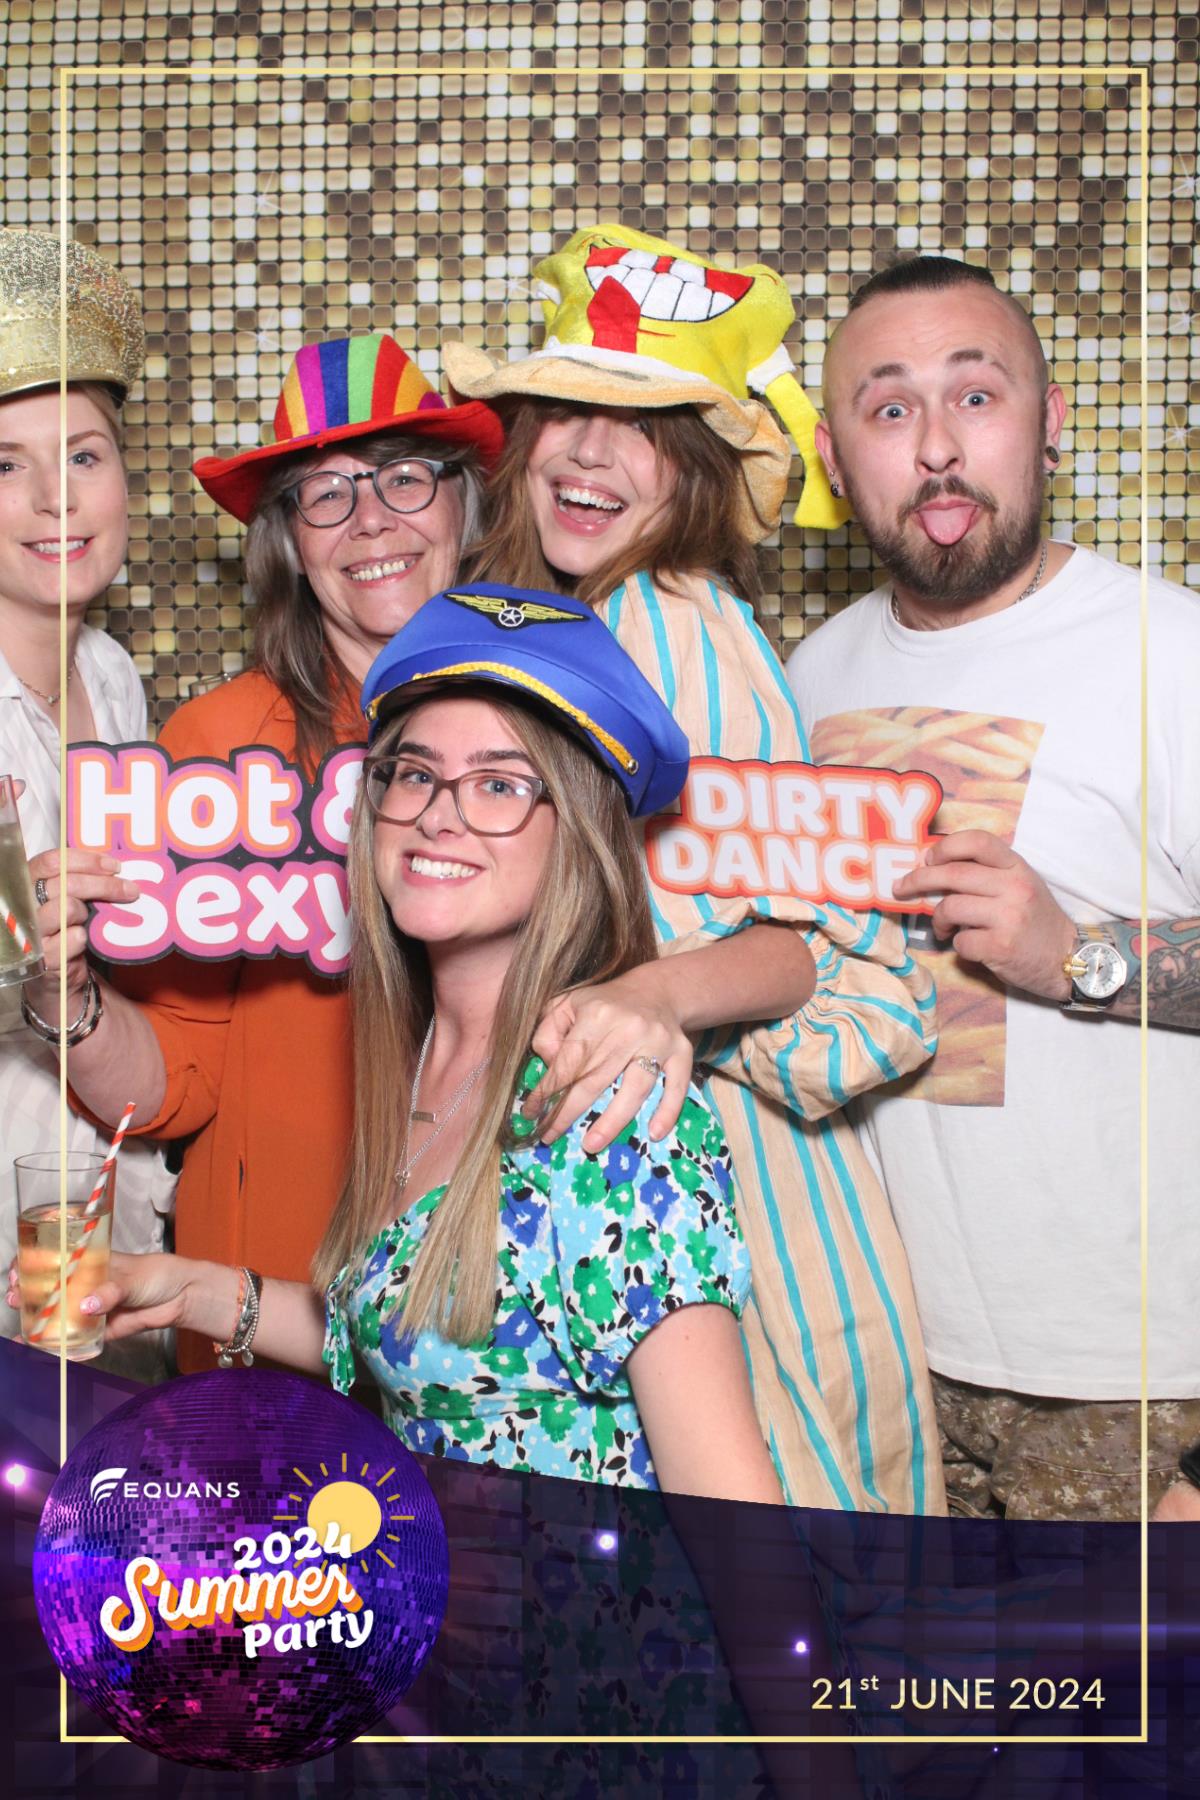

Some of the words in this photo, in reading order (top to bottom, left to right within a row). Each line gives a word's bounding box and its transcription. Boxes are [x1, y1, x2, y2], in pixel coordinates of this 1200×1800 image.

[80, 760, 291, 847] Hot
[692, 771, 927, 841] DIRTY
[657, 829, 943, 904] DANCE
[102, 859, 351, 962] Sexy
